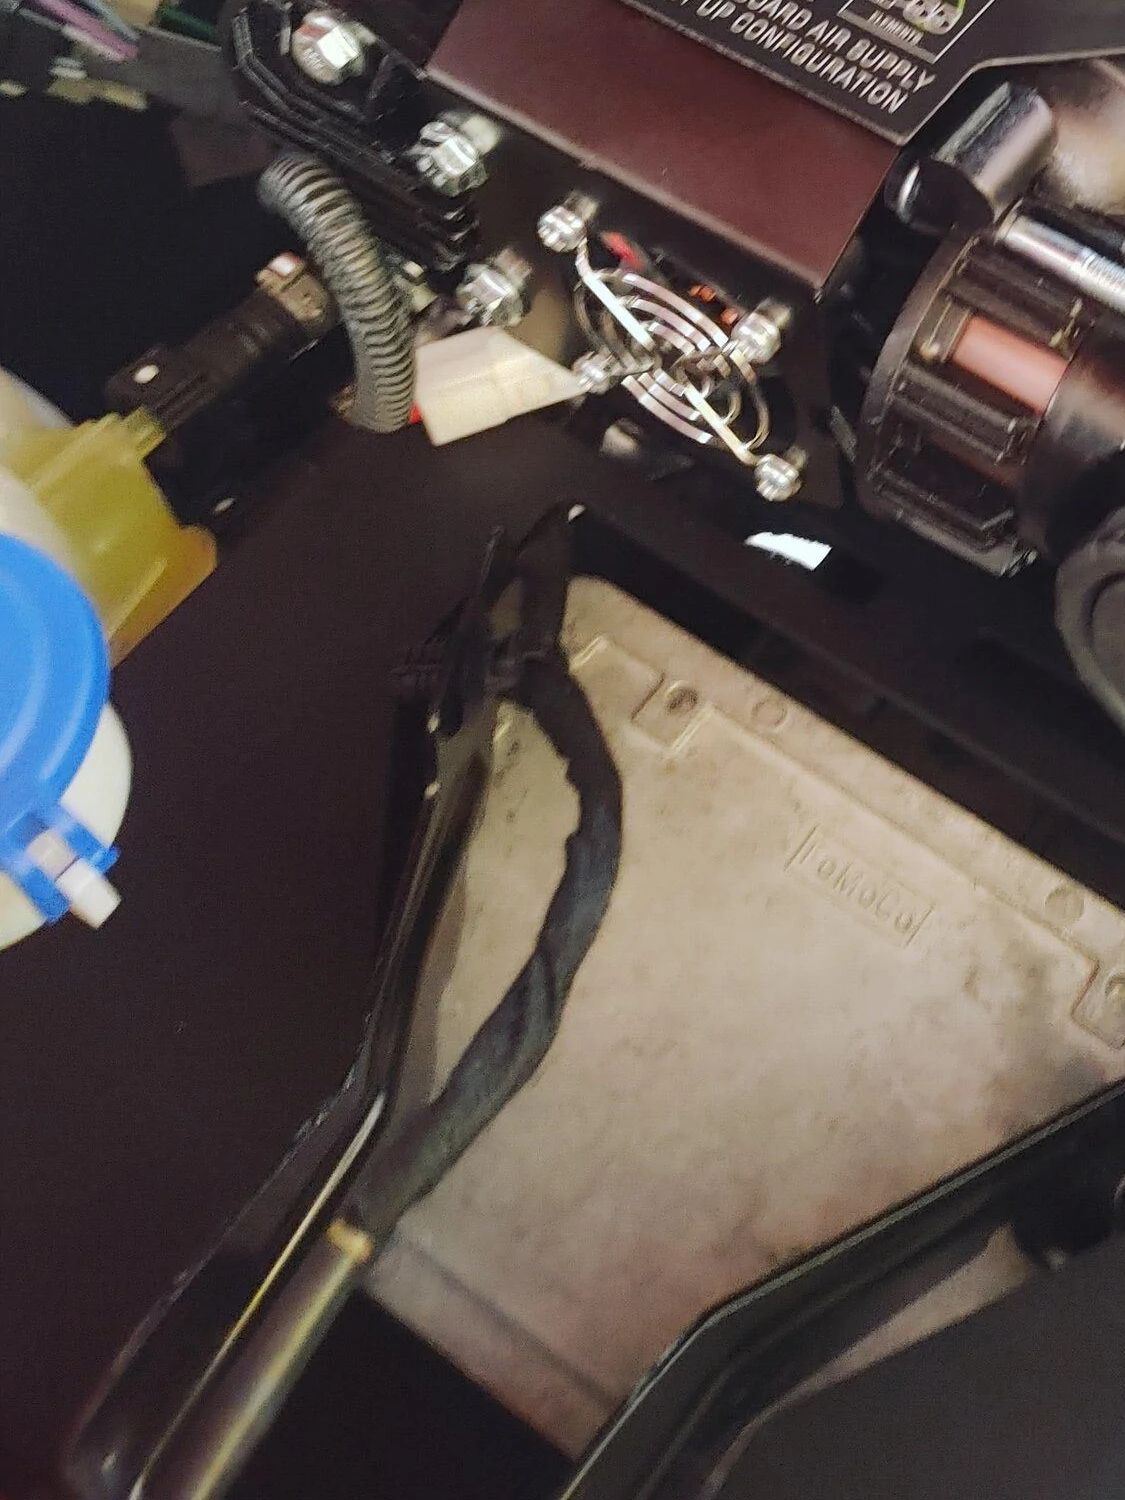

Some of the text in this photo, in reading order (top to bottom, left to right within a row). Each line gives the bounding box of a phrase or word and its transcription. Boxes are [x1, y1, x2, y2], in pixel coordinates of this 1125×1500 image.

[729, 11, 909, 115] CONFIGURATION
[804, 19, 851, 53] AIR
[846, 37, 937, 94] SUPPLY
